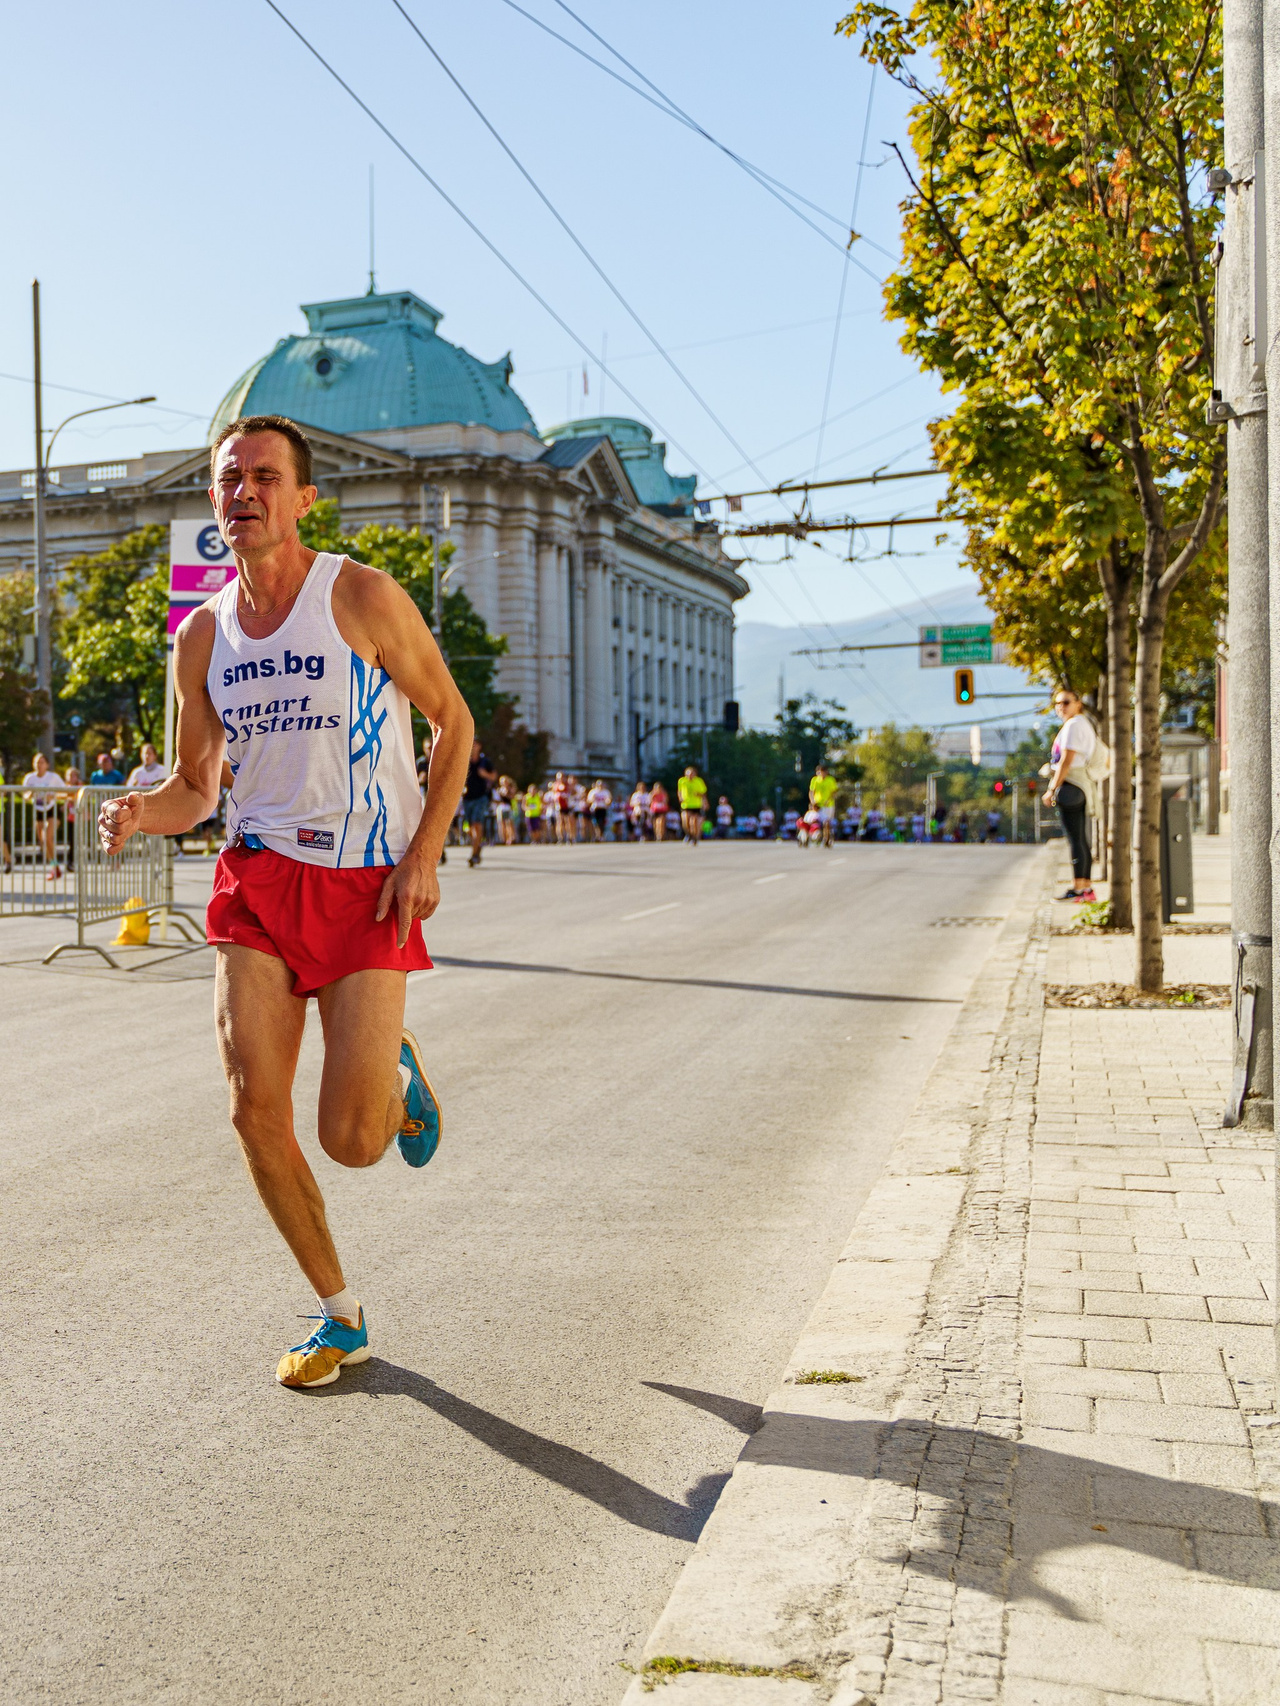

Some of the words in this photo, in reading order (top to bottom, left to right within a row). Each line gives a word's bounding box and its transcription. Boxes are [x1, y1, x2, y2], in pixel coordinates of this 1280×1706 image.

[204, 530, 224, 556] 3
[223, 650, 325, 687] sms.bg
[222, 695, 312, 742] Smart
[222, 713, 341, 744] Systems
